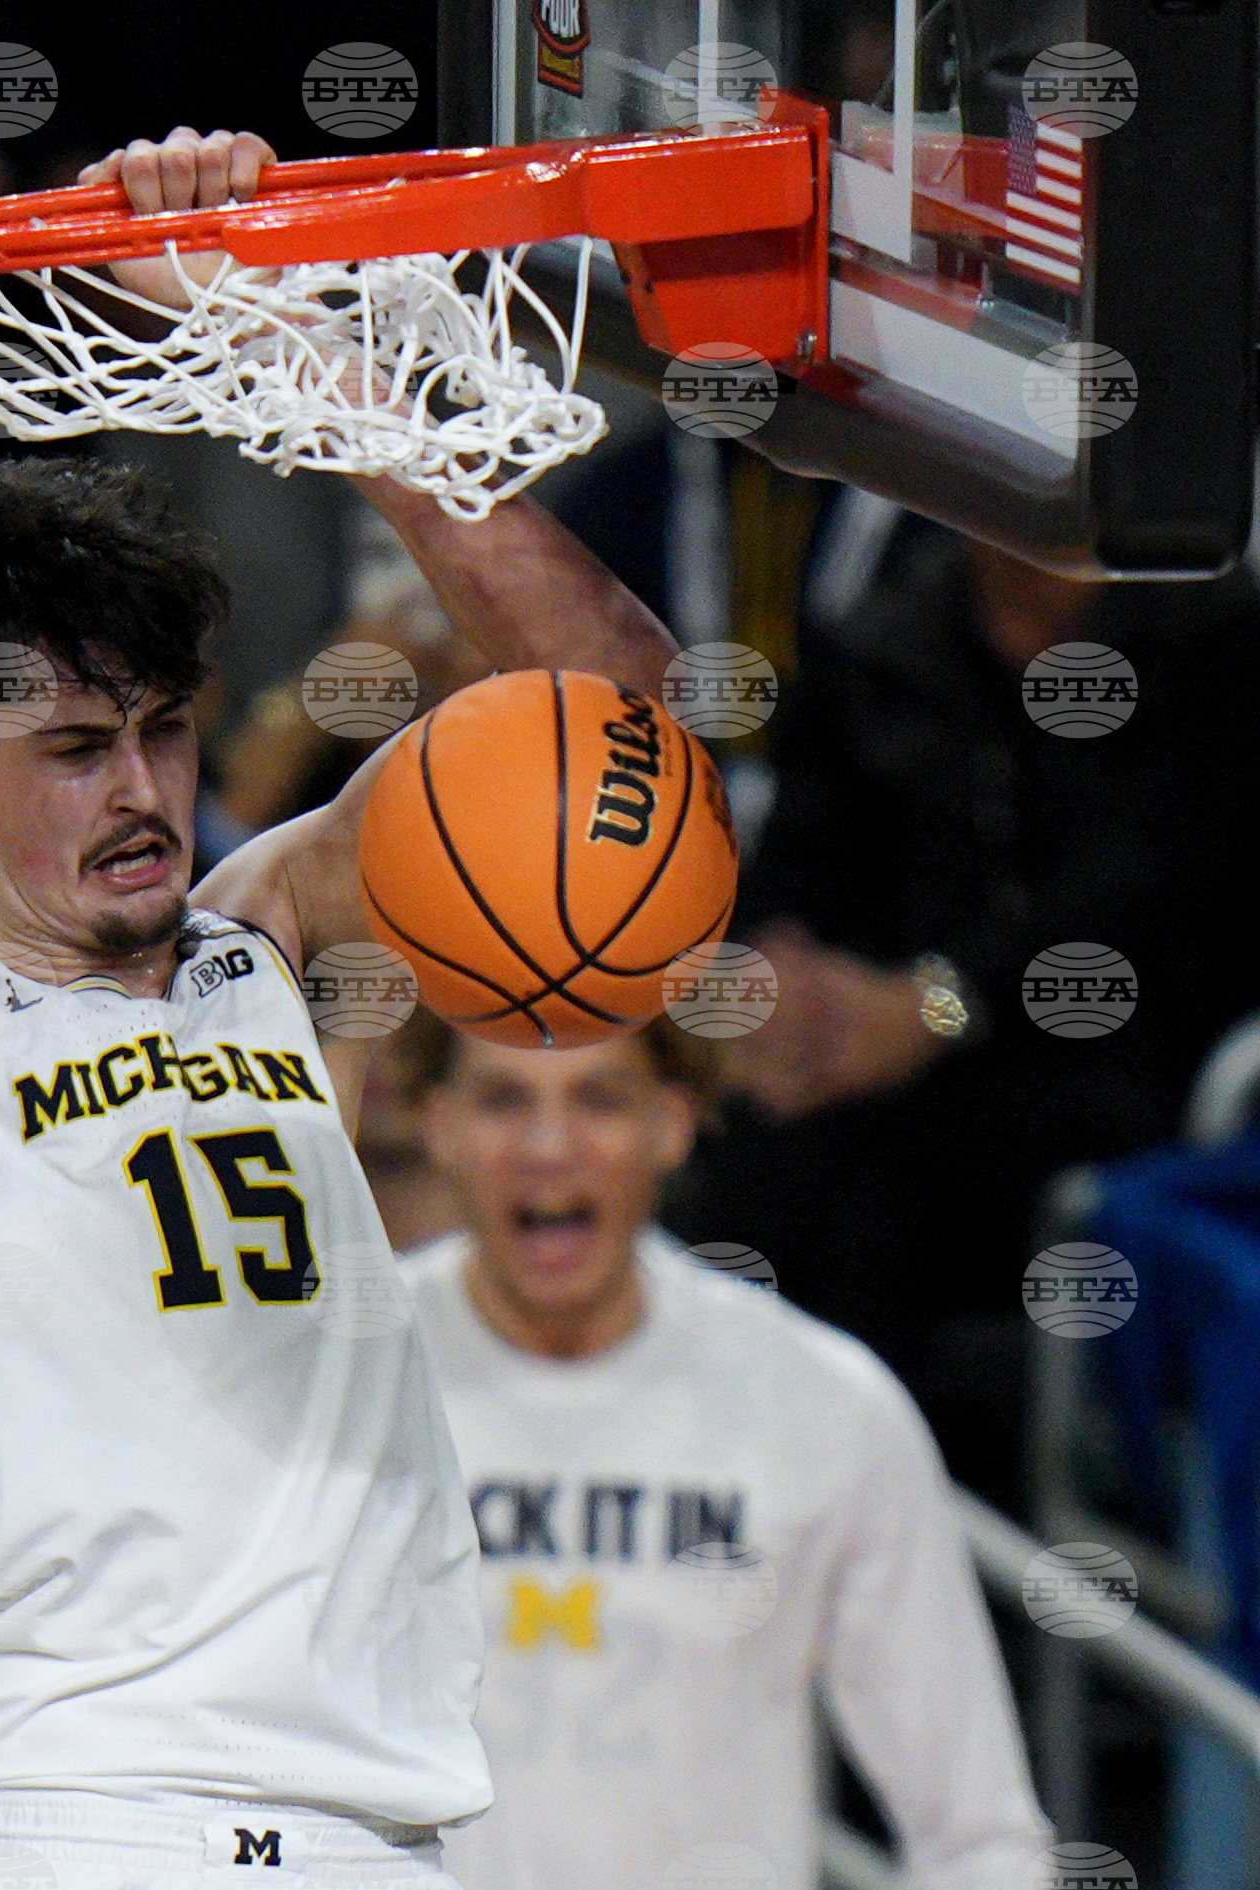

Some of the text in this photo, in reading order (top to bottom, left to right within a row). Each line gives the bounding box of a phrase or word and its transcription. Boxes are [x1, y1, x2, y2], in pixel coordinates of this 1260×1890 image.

[122, 1125, 321, 1313] 15
[505, 1572, 603, 1650] M
[233, 1828, 282, 1866] M
